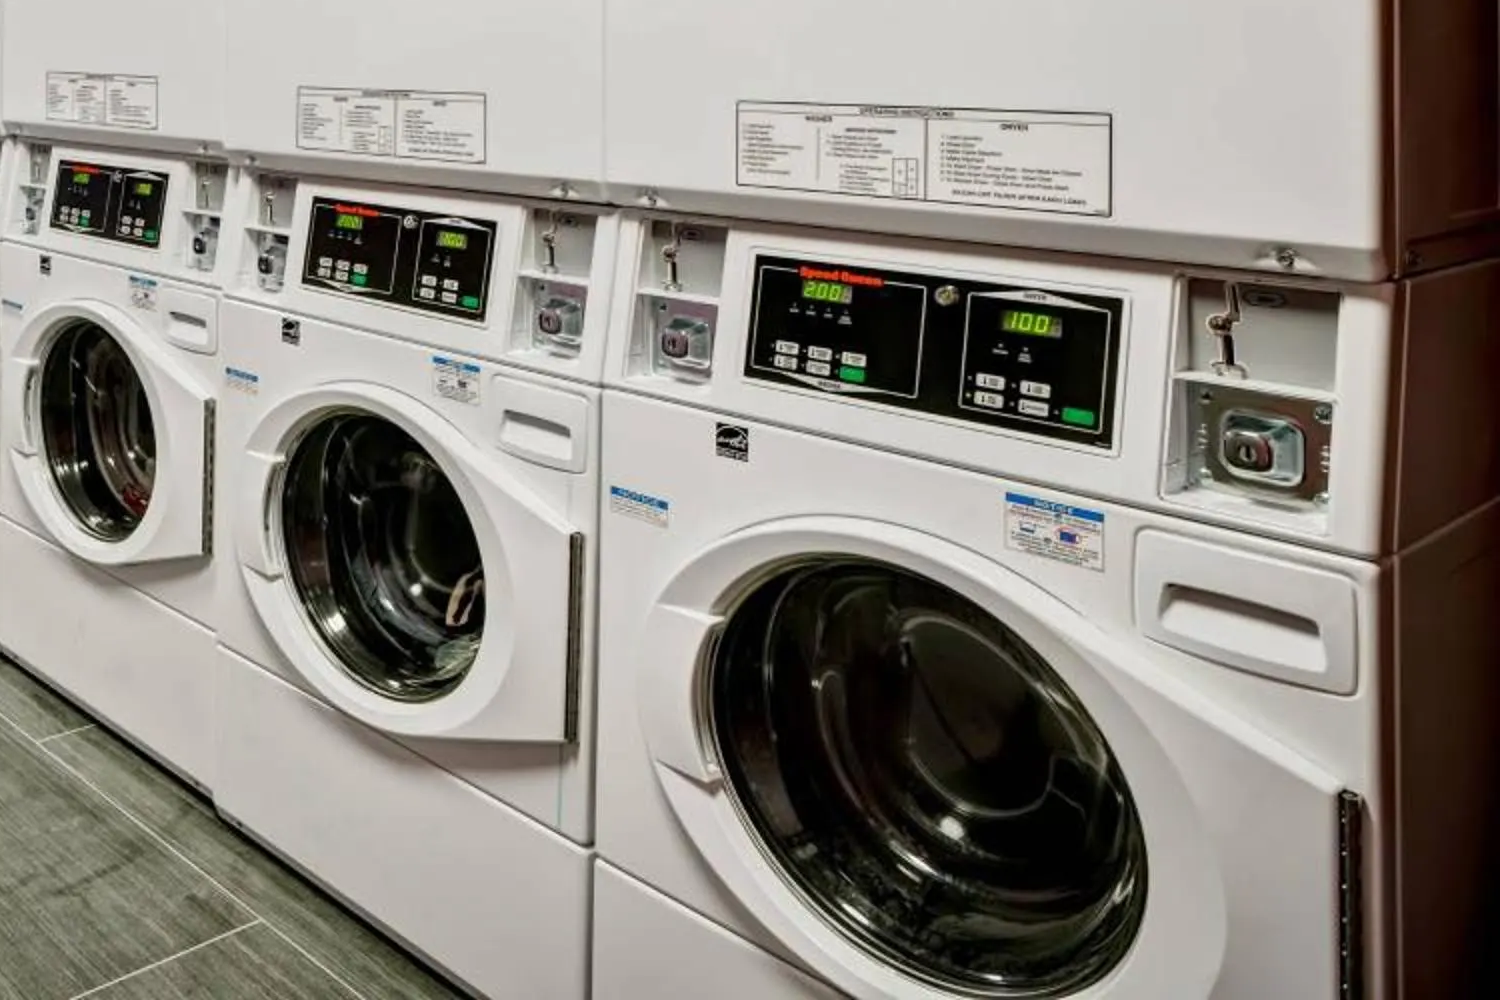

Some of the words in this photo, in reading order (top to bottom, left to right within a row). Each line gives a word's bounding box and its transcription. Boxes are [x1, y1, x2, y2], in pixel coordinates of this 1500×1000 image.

[800, 266, 839, 281] Speed
[841, 271, 883, 288] Queen
[802, 281, 841, 301] 200
[1011, 311, 1050, 333] 100
